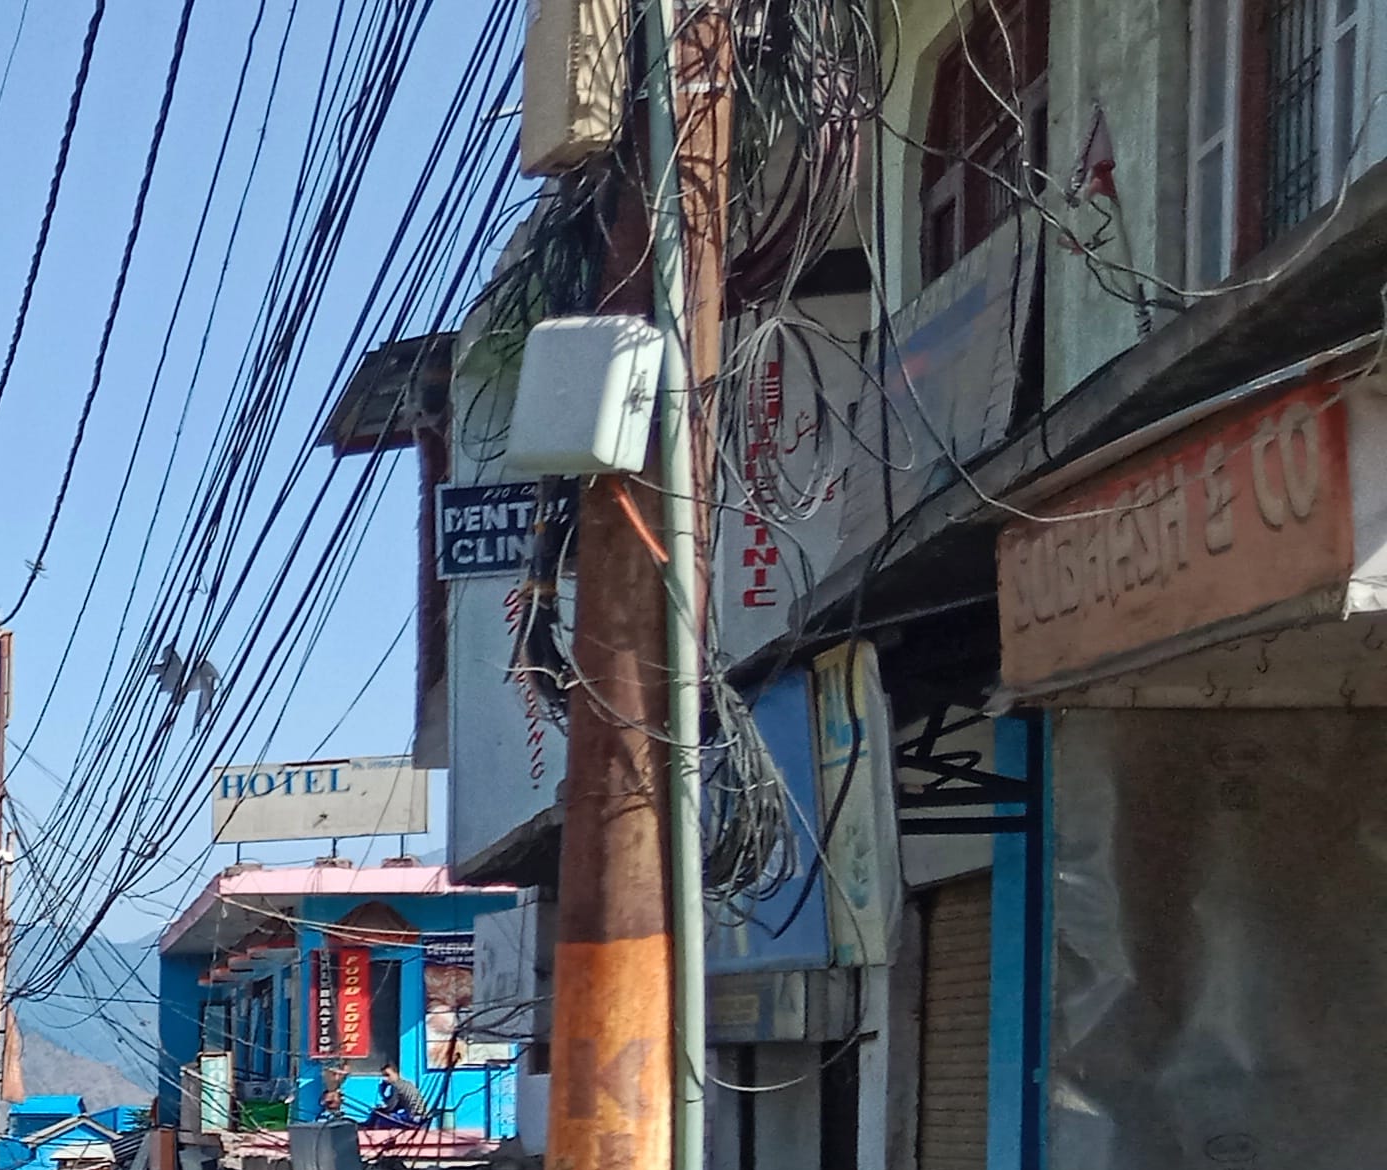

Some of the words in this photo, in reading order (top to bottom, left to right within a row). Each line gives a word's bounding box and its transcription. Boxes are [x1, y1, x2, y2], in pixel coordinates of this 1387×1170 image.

[221, 767, 351, 799] HOTEL
[344, 955, 361, 996] FOOD
[343, 1001, 360, 1053] COURT
